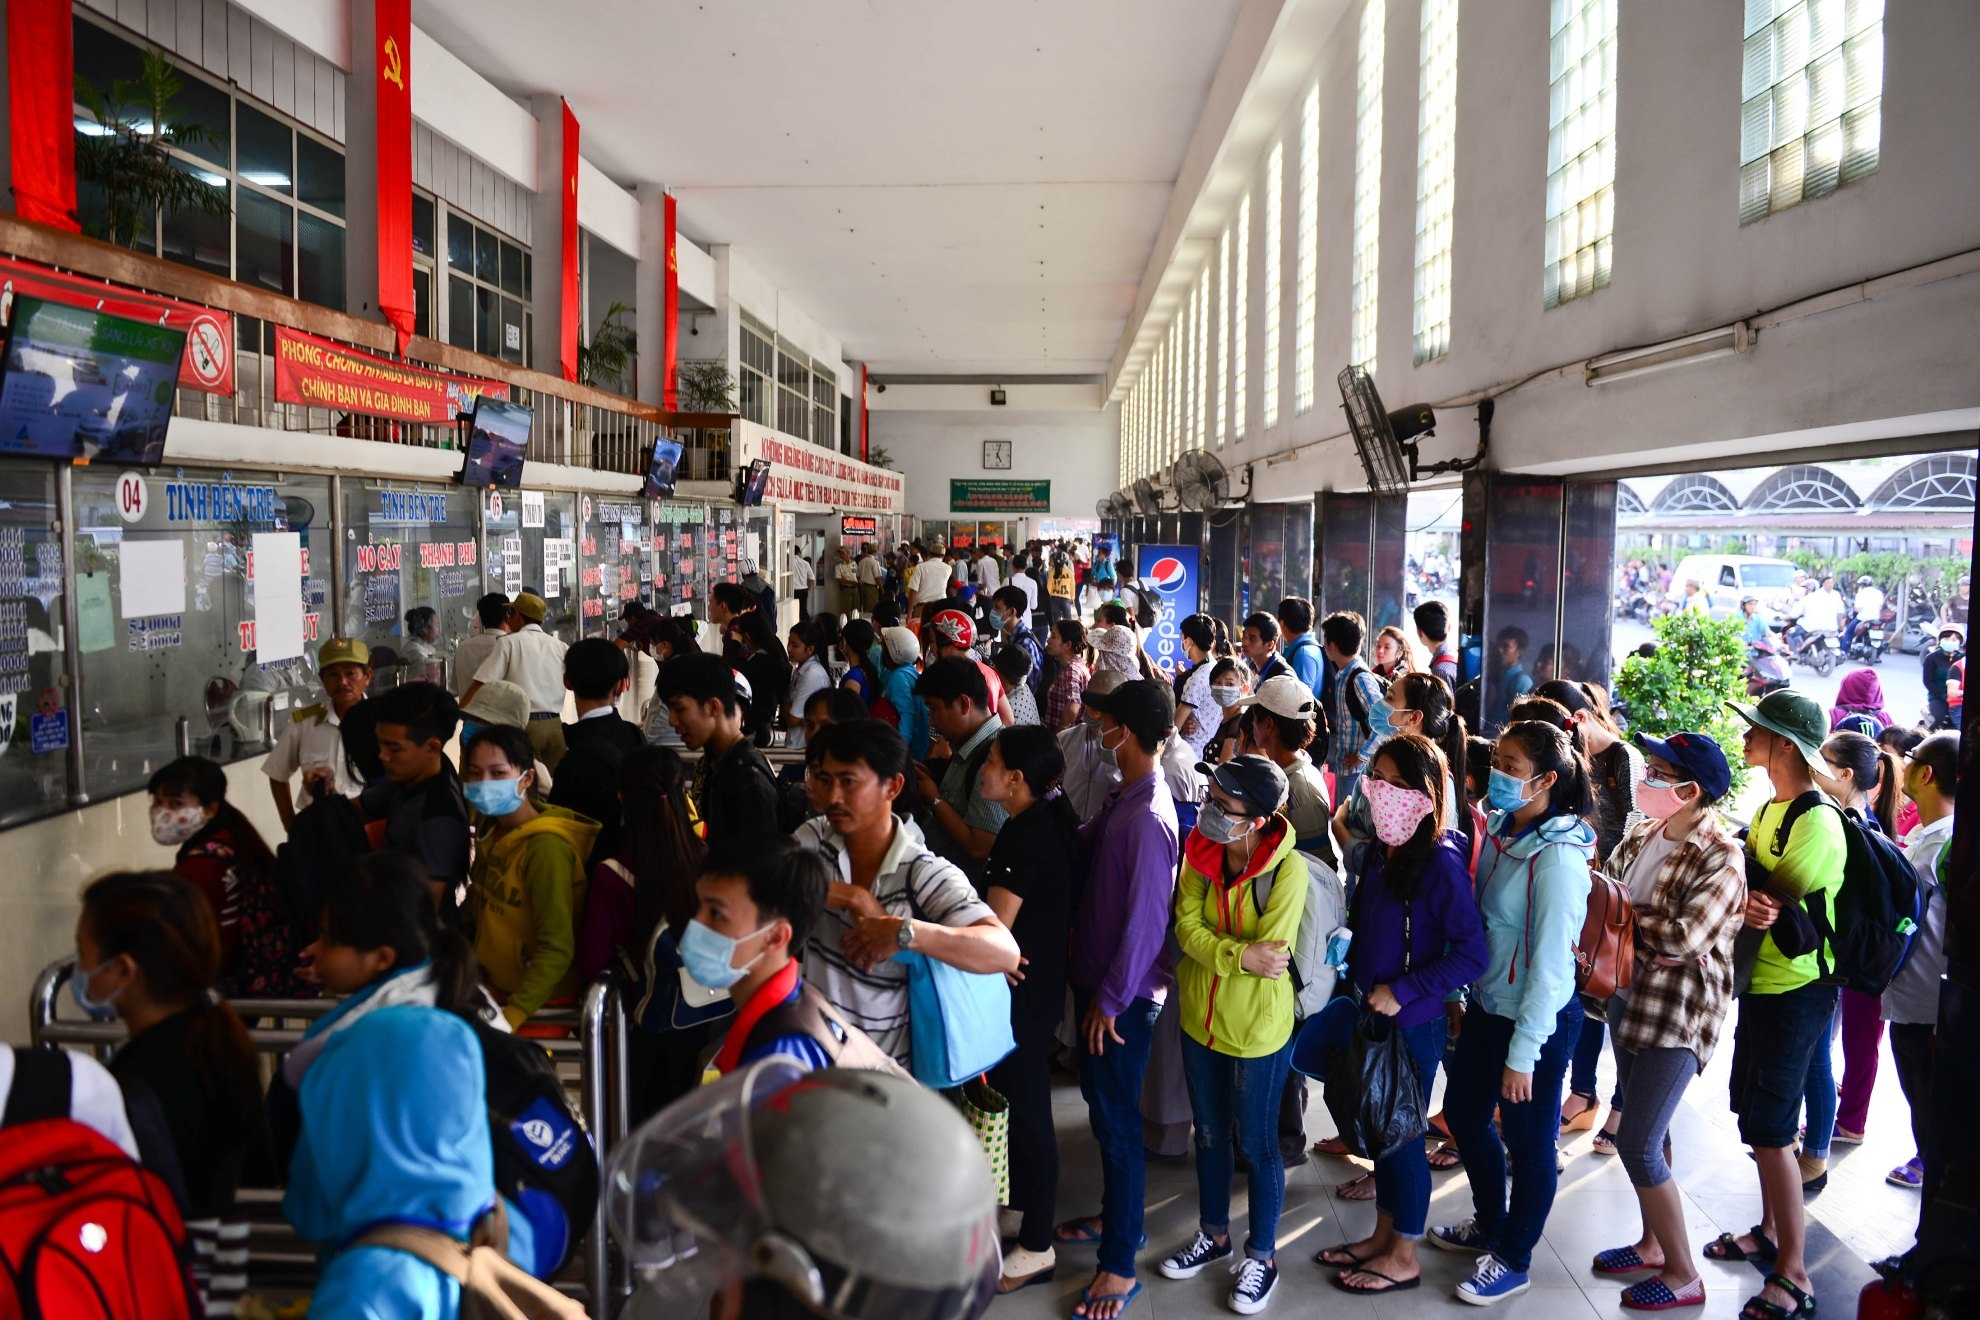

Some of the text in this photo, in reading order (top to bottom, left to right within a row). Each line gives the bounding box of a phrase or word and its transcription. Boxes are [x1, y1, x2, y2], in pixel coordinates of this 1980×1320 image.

[301, 376, 336, 402] CHÍNH
[337, 387, 358, 409] BẠN
[359, 385, 373, 409] VÀ
[375, 392, 389, 412] GIA
[391, 393, 412, 415] ĐÌNH
[414, 400, 431, 421] BẠN
[762, 437, 782, 464] KHÔNG
[815, 455, 824, 474] CAO
[123, 479, 141, 513] 04
[166, 467, 275, 521] TỈNH BẾN TRE
[381, 481, 447, 522] TỈNH BẾN TRE
[785, 477, 792, 499] LÀ
[378, 538, 401, 571] CÀY
[420, 537, 476, 571] THẠNH PHÚ
[1157, 600, 1180, 672] pepsi
